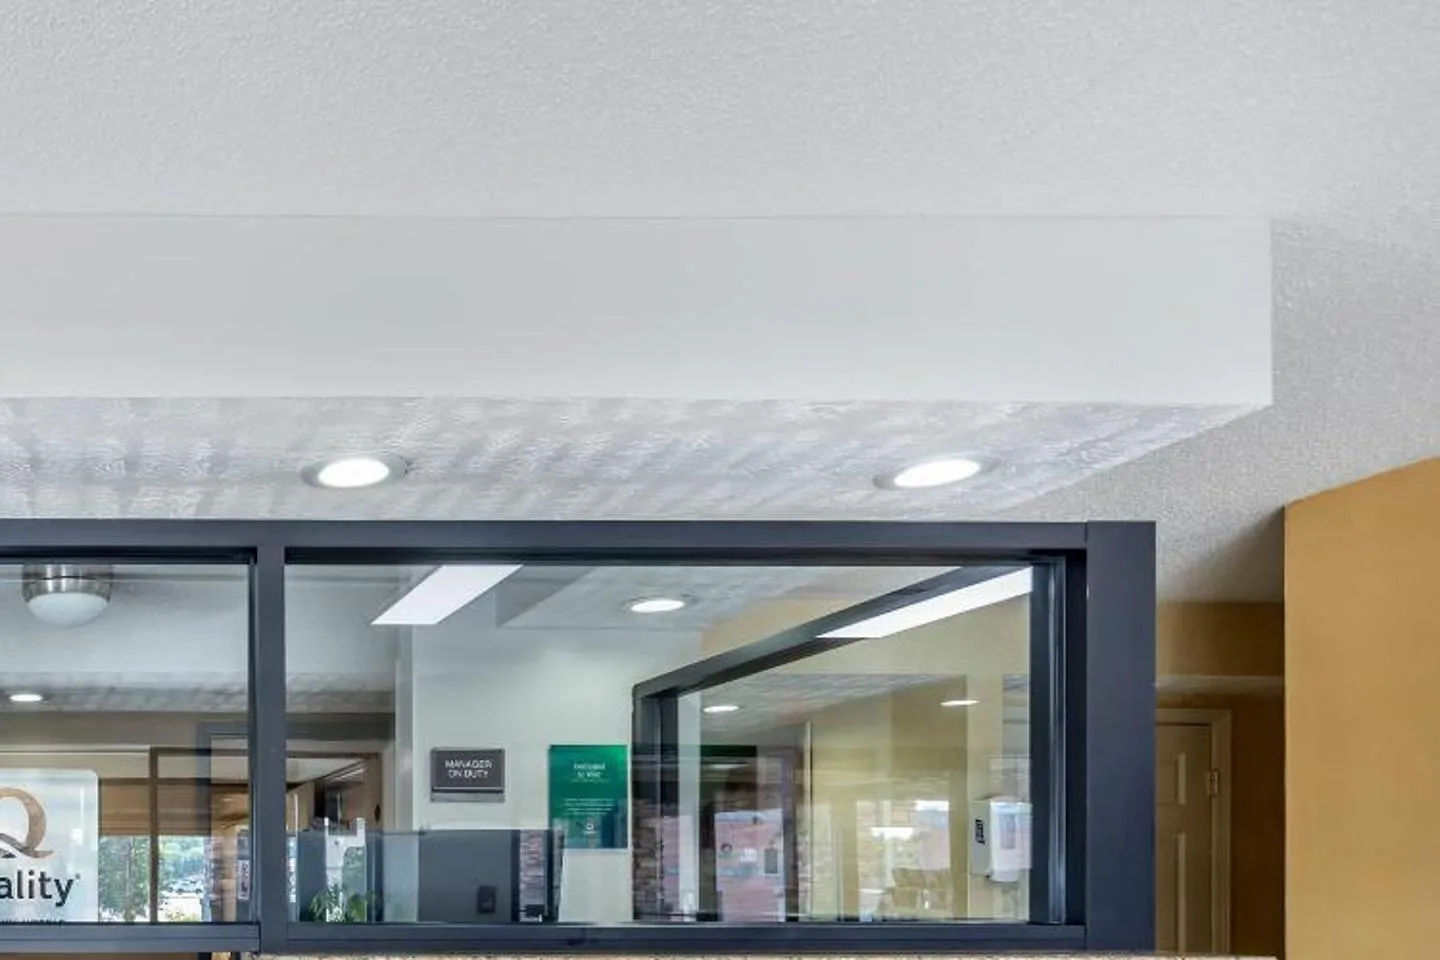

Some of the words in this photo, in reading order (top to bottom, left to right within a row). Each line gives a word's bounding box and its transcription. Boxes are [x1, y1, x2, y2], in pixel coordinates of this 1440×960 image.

[444, 759, 493, 769] MANAGER
[448, 769, 462, 779] ON
[464, 769, 489, 778] DUTY
